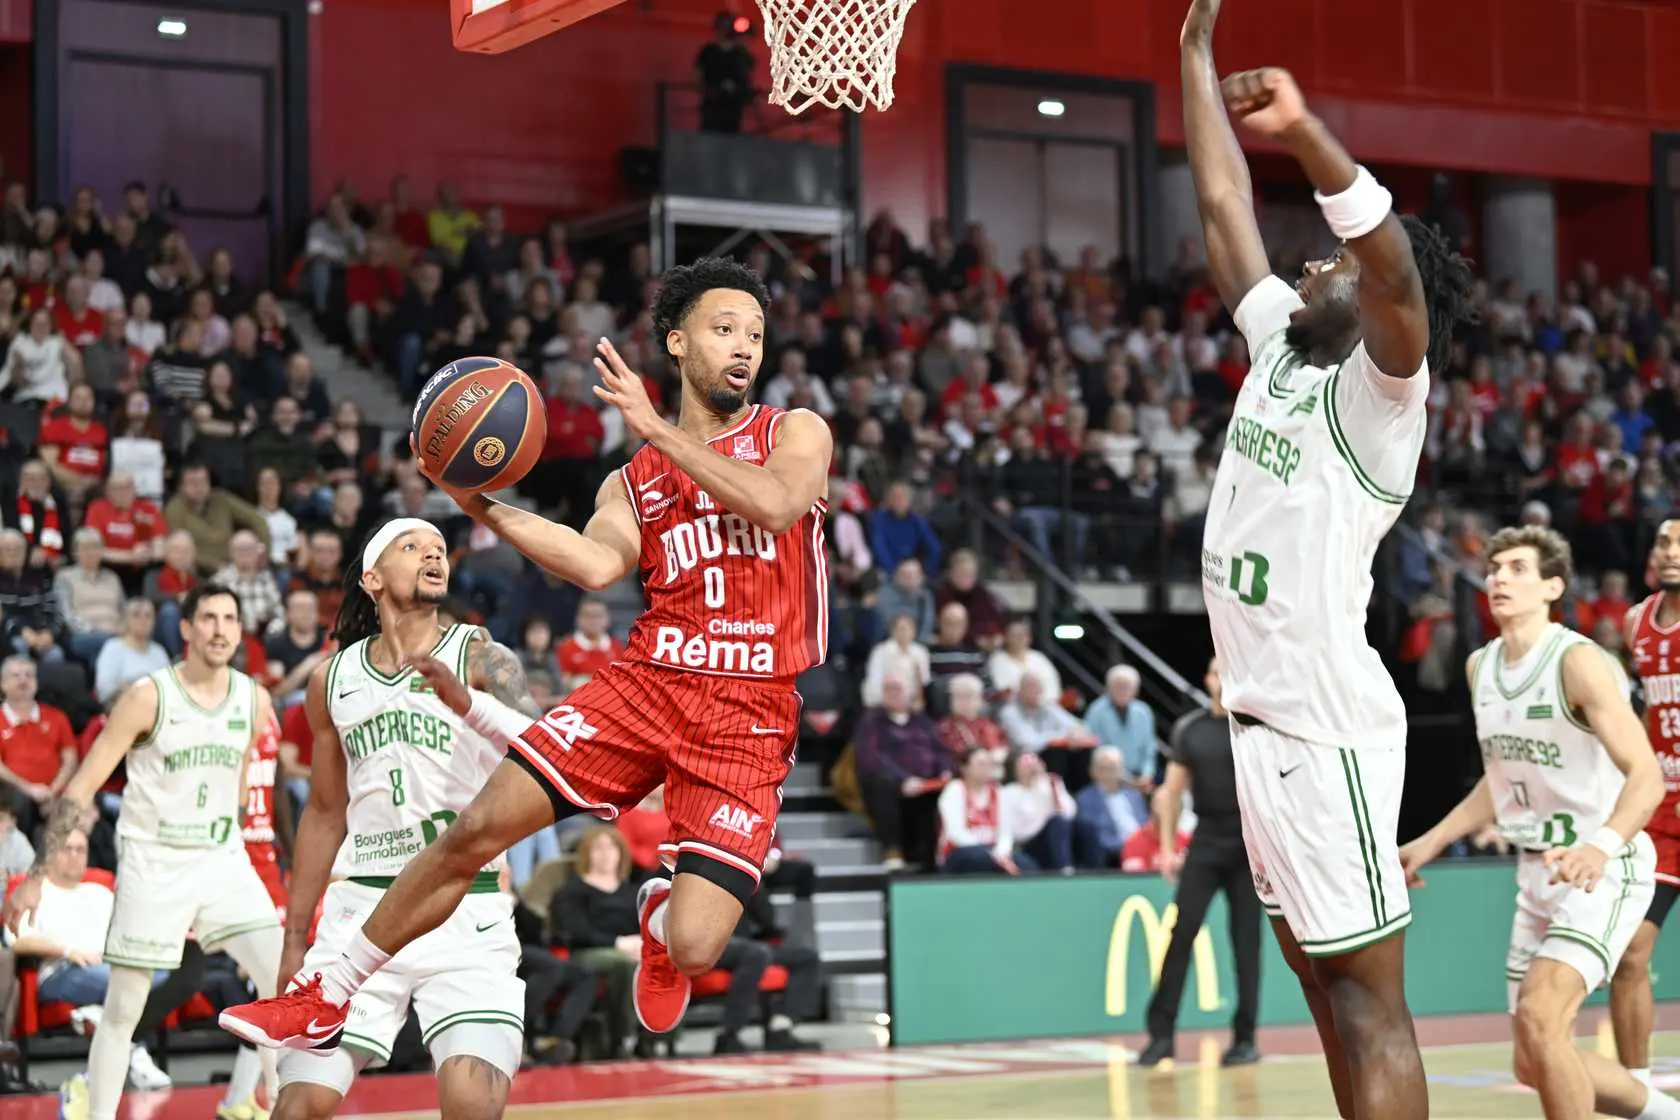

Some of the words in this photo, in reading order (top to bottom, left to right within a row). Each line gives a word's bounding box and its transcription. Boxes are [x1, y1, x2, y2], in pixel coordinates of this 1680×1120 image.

[704, 566, 725, 609] 0
[708, 618, 776, 636] Charles
[651, 626, 774, 673] Réma
[197, 781, 208, 809] 6
[389, 767, 406, 807] 8
[708, 803, 753, 834] AIN
[354, 827, 415, 848] Bouygues
[355, 842, 422, 864] Immobilier
